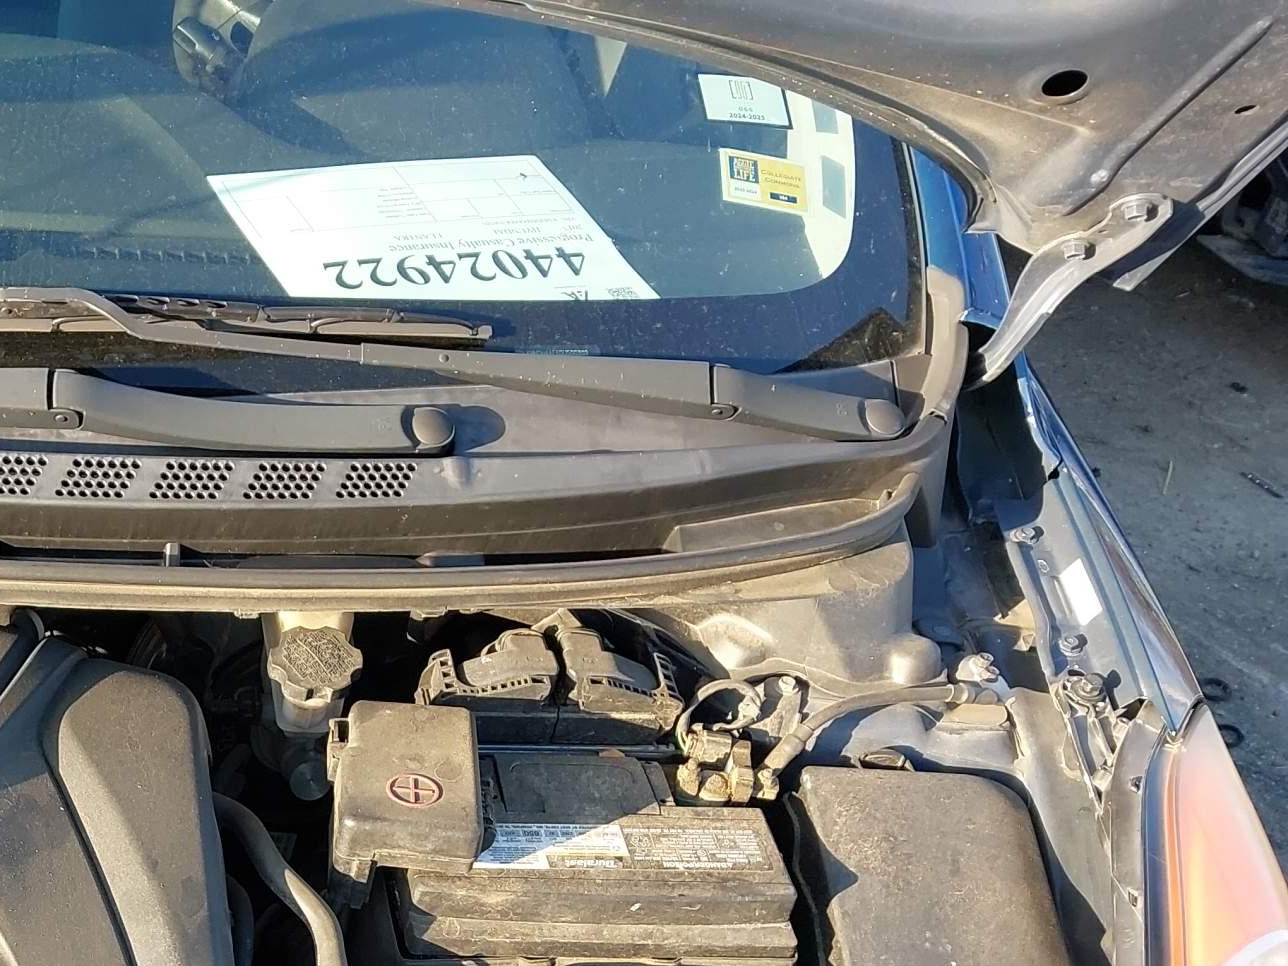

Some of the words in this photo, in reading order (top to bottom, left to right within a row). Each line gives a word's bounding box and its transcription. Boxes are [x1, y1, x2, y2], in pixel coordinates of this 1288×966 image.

[388, 242, 454, 252] Insurance
[458, 237, 516, 249] Casualty
[323, 247, 585, 290] 44024922
[565, 859, 617, 869] Duralast
